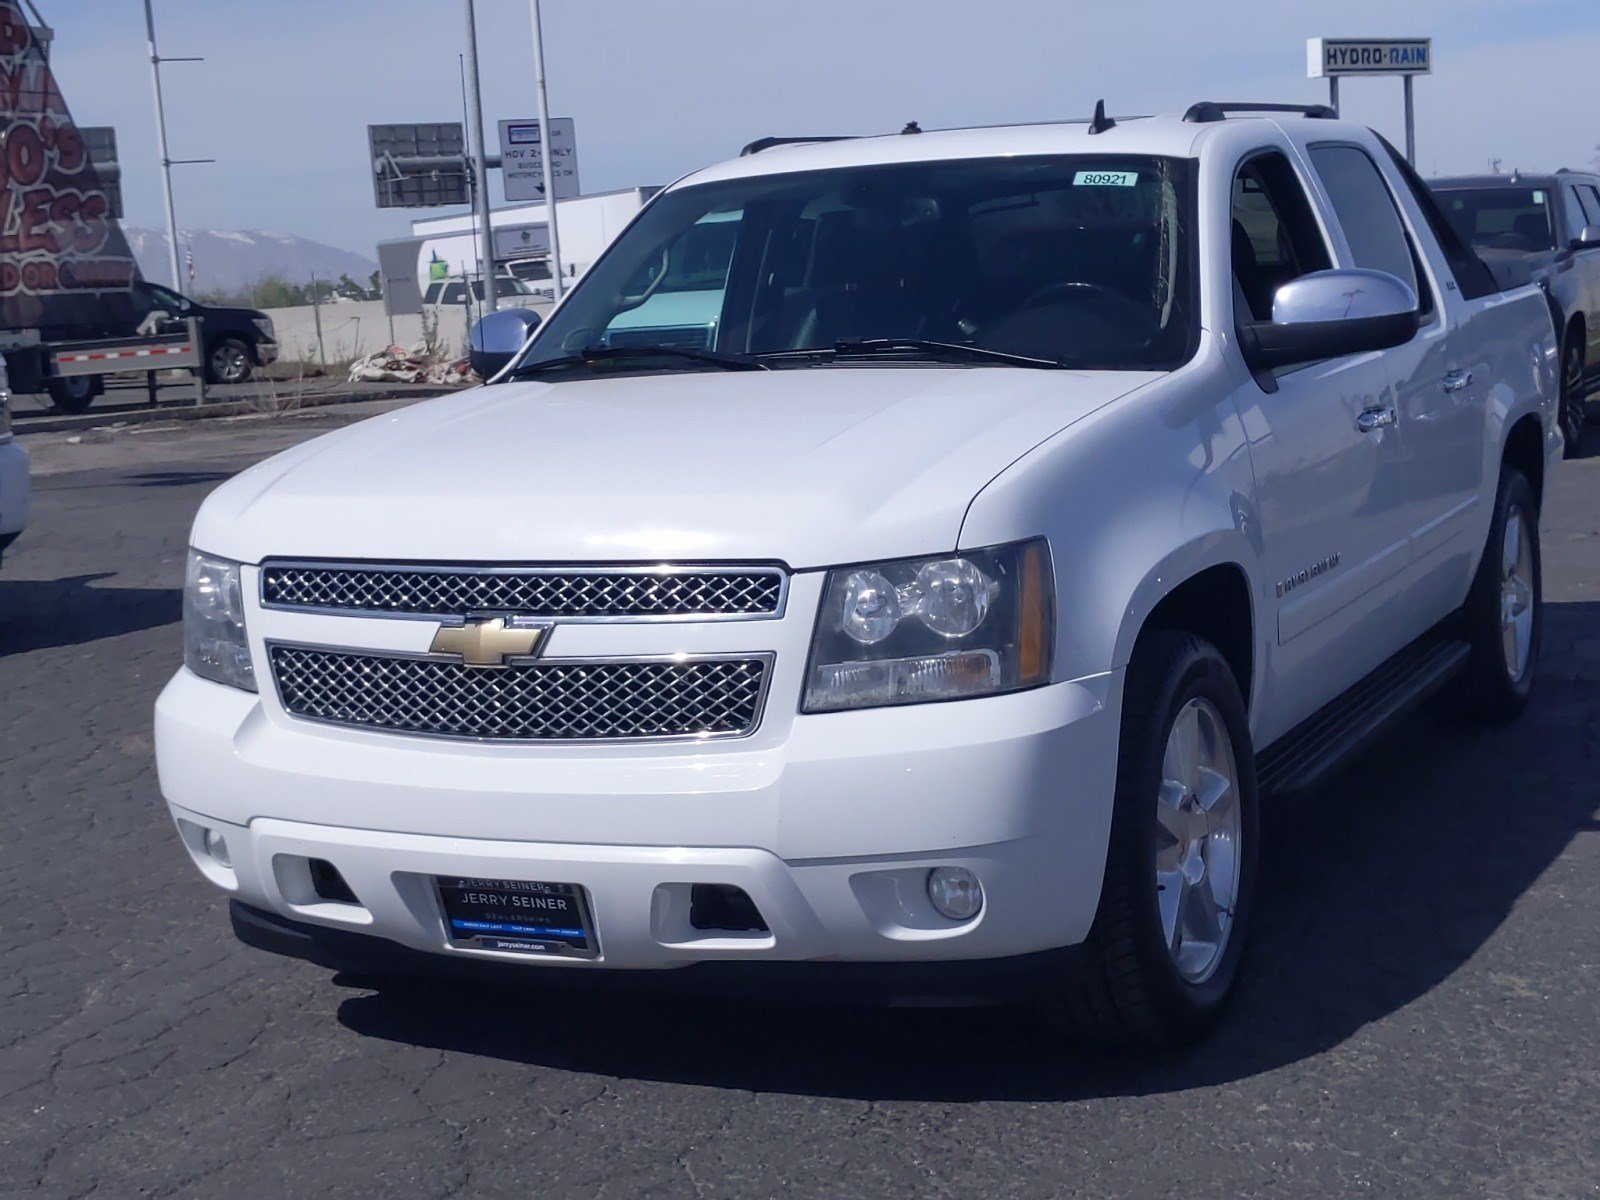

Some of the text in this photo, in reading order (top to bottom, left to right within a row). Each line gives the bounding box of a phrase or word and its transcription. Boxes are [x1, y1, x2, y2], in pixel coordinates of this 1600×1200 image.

[505, 149, 525, 159] HOV
[551, 147, 572, 157] NLY
[1083, 174, 1127, 185] 80921
[467, 879, 545, 892] JERRY SEINER
[462, 892, 567, 910] JERRY SEINER
